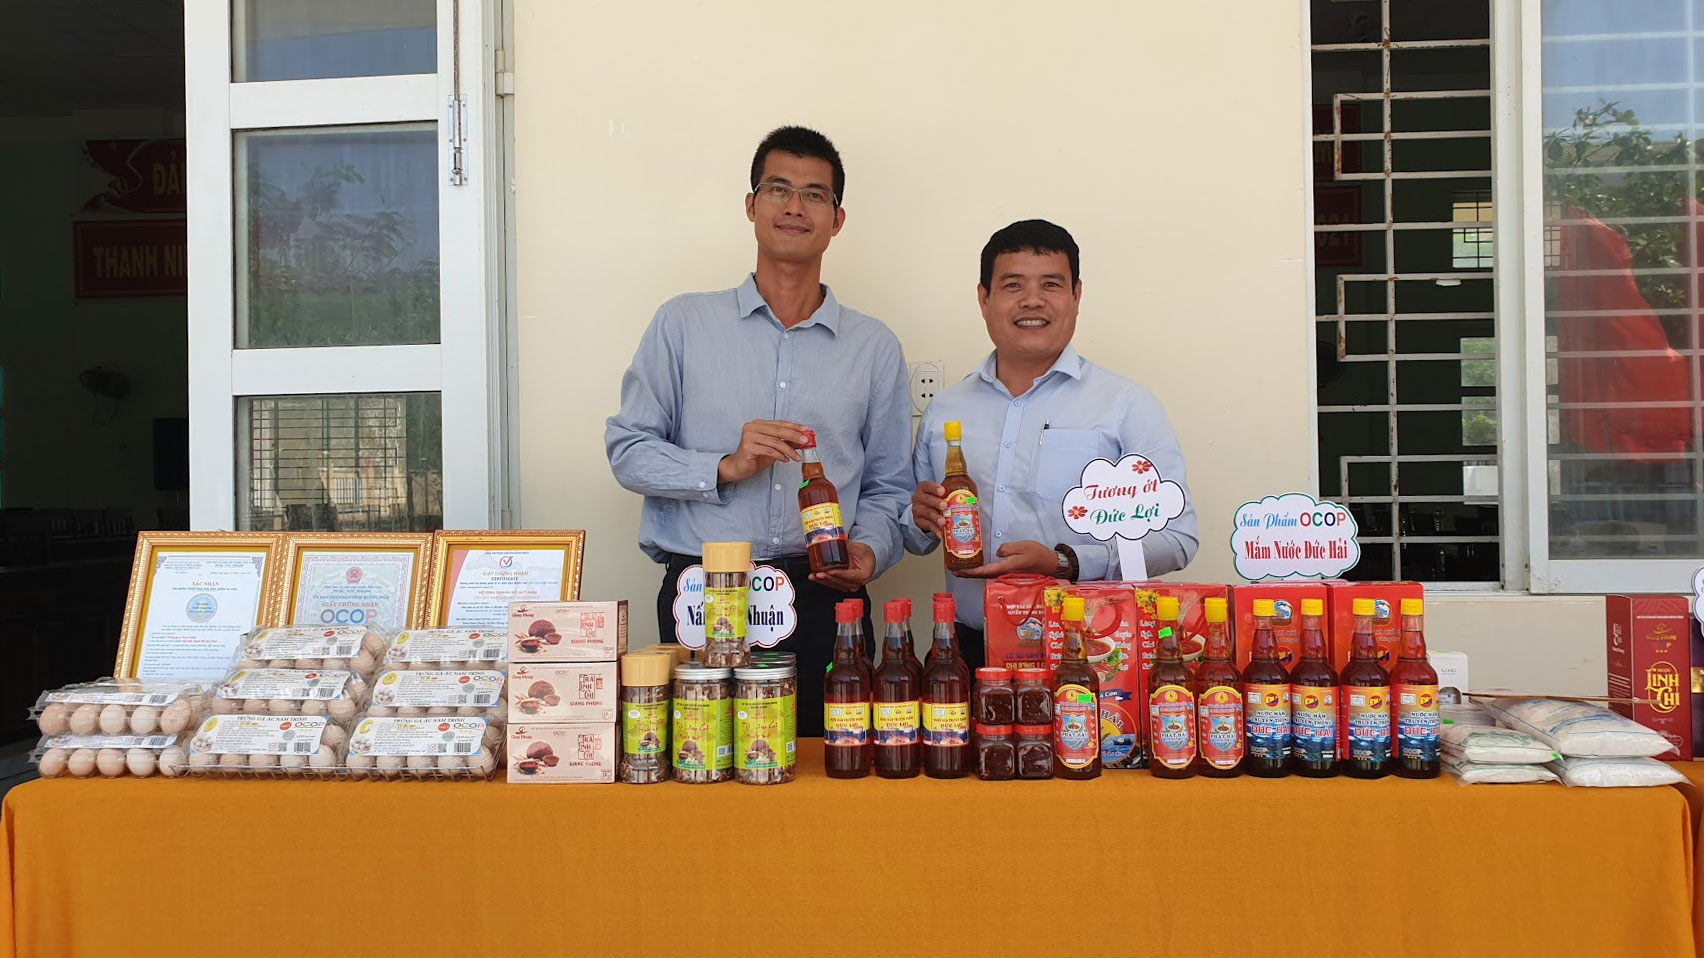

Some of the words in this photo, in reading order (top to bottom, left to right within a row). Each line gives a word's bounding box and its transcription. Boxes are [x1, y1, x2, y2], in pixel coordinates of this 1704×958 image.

[152, 150, 185, 196] ĐẢ
[92, 246, 160, 280] THANH
[164, 245, 185, 277] NI
[1083, 483, 1138, 501] Tương
[1143, 479, 1159, 494] ớt
[1089, 507, 1126, 525] Đức
[1131, 503, 1160, 524] Lợi
[1239, 512, 1261, 528] Sản
[1262, 512, 1298, 529] Phẩm
[1299, 511, 1346, 527] OCOP
[1245, 535, 1271, 560] Mắm
[1273, 538, 1302, 560] Nước
[1304, 537, 1327, 560] Đức
[1328, 536, 1348, 560] Hải
[684, 577, 703, 592] Sản
[749, 576, 785, 591] COP
[320, 608, 378, 623] OCOP
[1645, 668, 1680, 691] LINH
[1657, 686, 1680, 710] CHI
